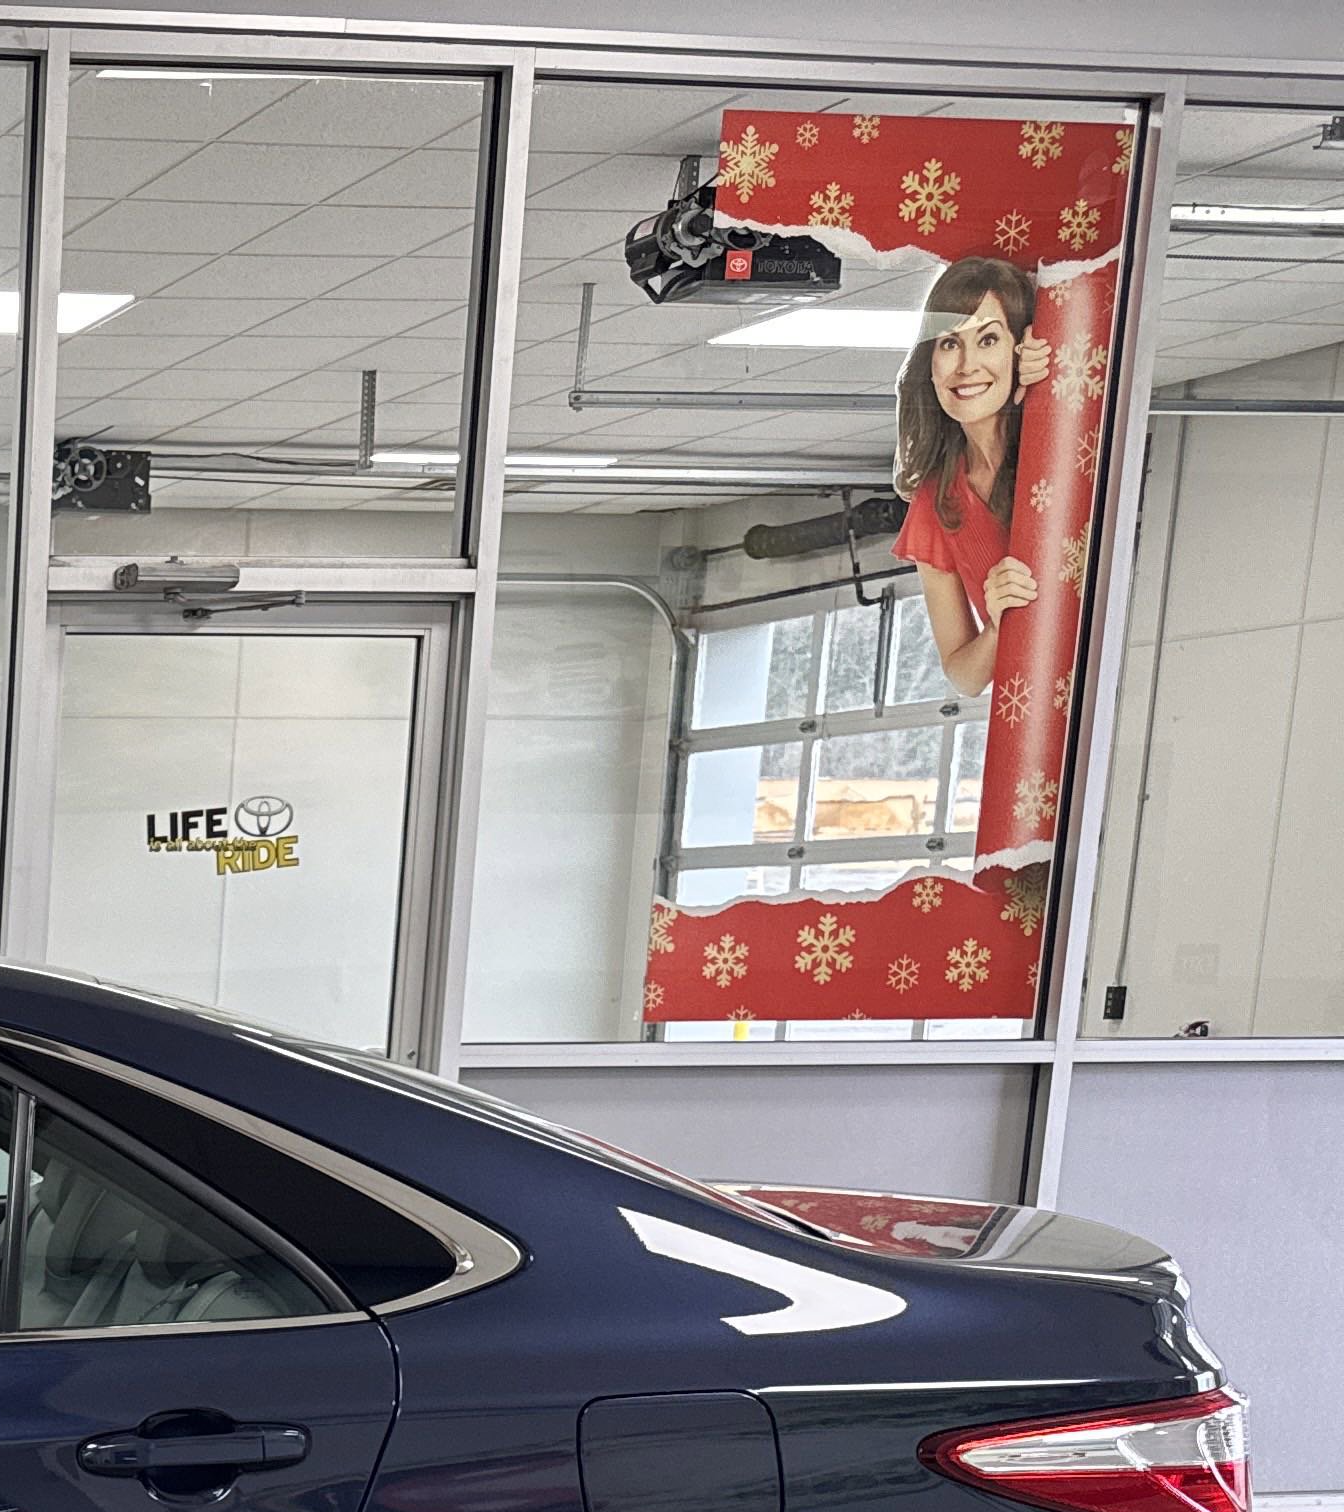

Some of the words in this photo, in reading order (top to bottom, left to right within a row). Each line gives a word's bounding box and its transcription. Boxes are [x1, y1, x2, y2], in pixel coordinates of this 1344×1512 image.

[757, 259, 815, 275] TOYOTA
[147, 807, 228, 845] LIFE
[216, 835, 300, 875] RIDE
